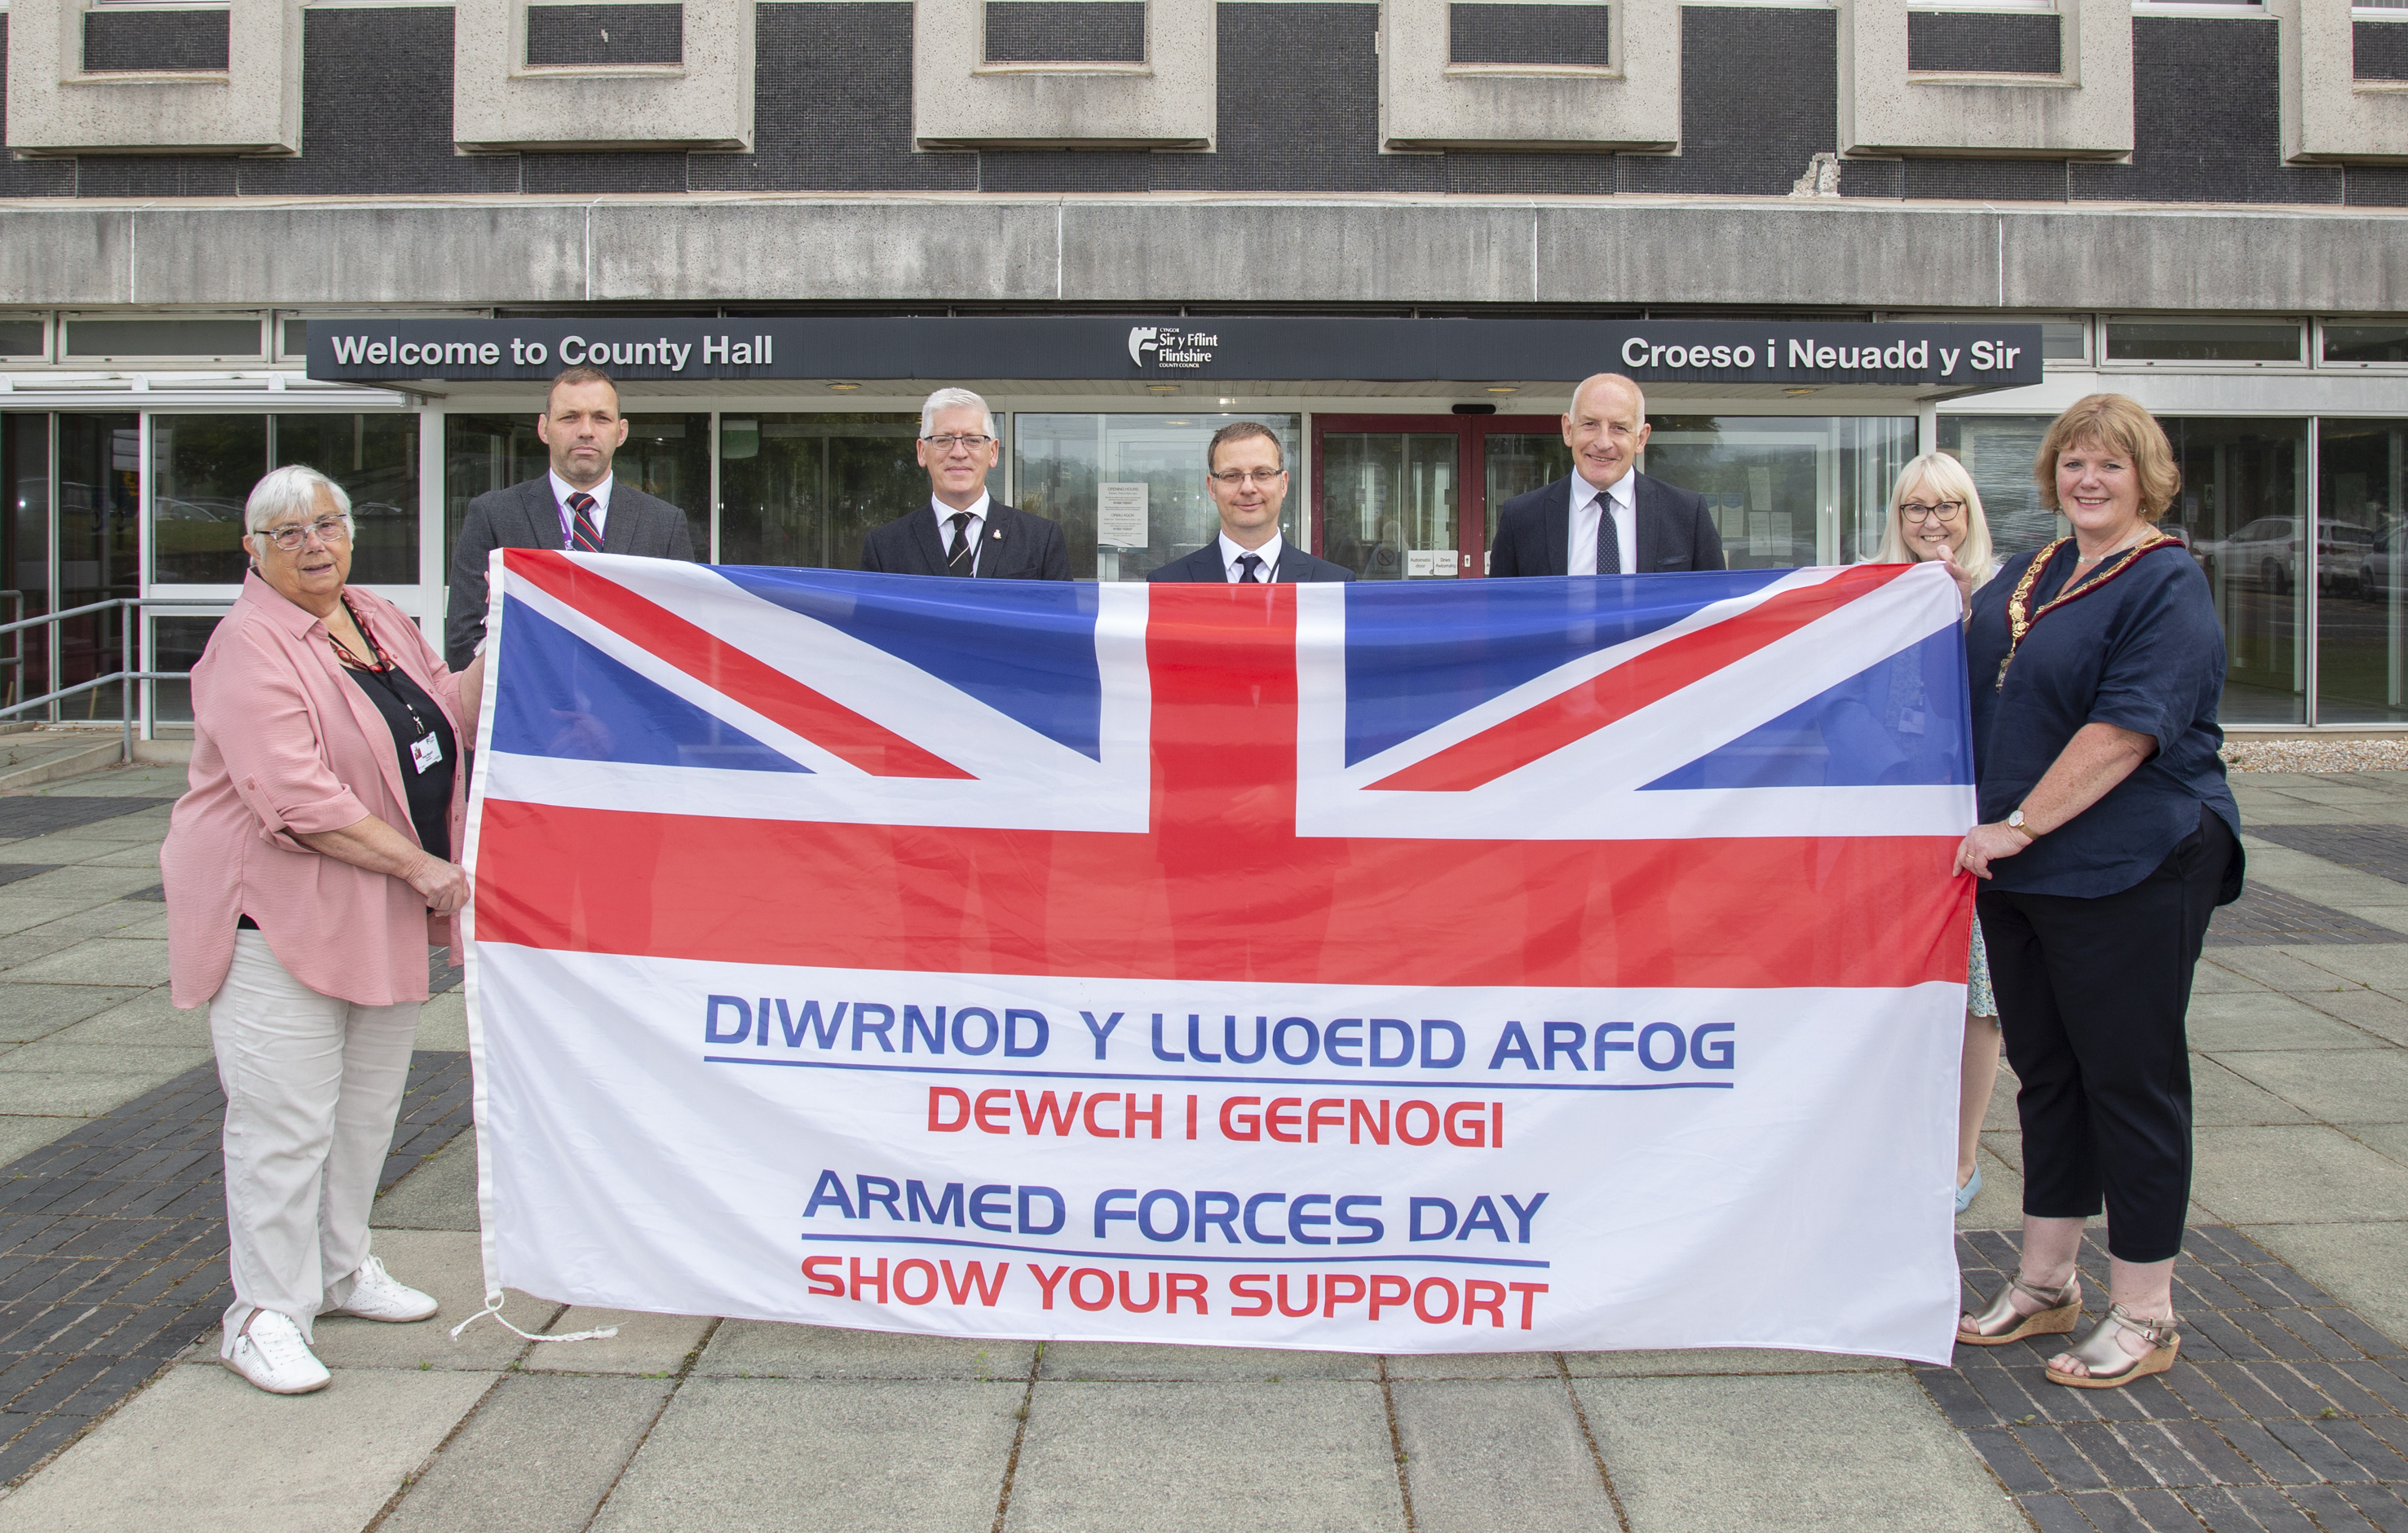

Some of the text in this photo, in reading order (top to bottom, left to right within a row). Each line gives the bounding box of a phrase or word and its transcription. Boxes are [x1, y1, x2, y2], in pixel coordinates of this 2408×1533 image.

[332, 335, 772, 372] Welcome to County Hall
[1159, 348, 1213, 362] Flintshire
[1160, 333, 1218, 350] Sir y Fflint
[1621, 337, 2021, 377] Croeso i Neuadd y Sir
[705, 994, 1736, 1073] DIWRNOD Y LLUOEDD ARFOG
[928, 1086, 1503, 1148] DEWCH I GEFNOGI
[802, 1169, 1550, 1248] ARMED FORCES DAY
[802, 1256, 1549, 1330] SHOW YOUR SUPPORT
